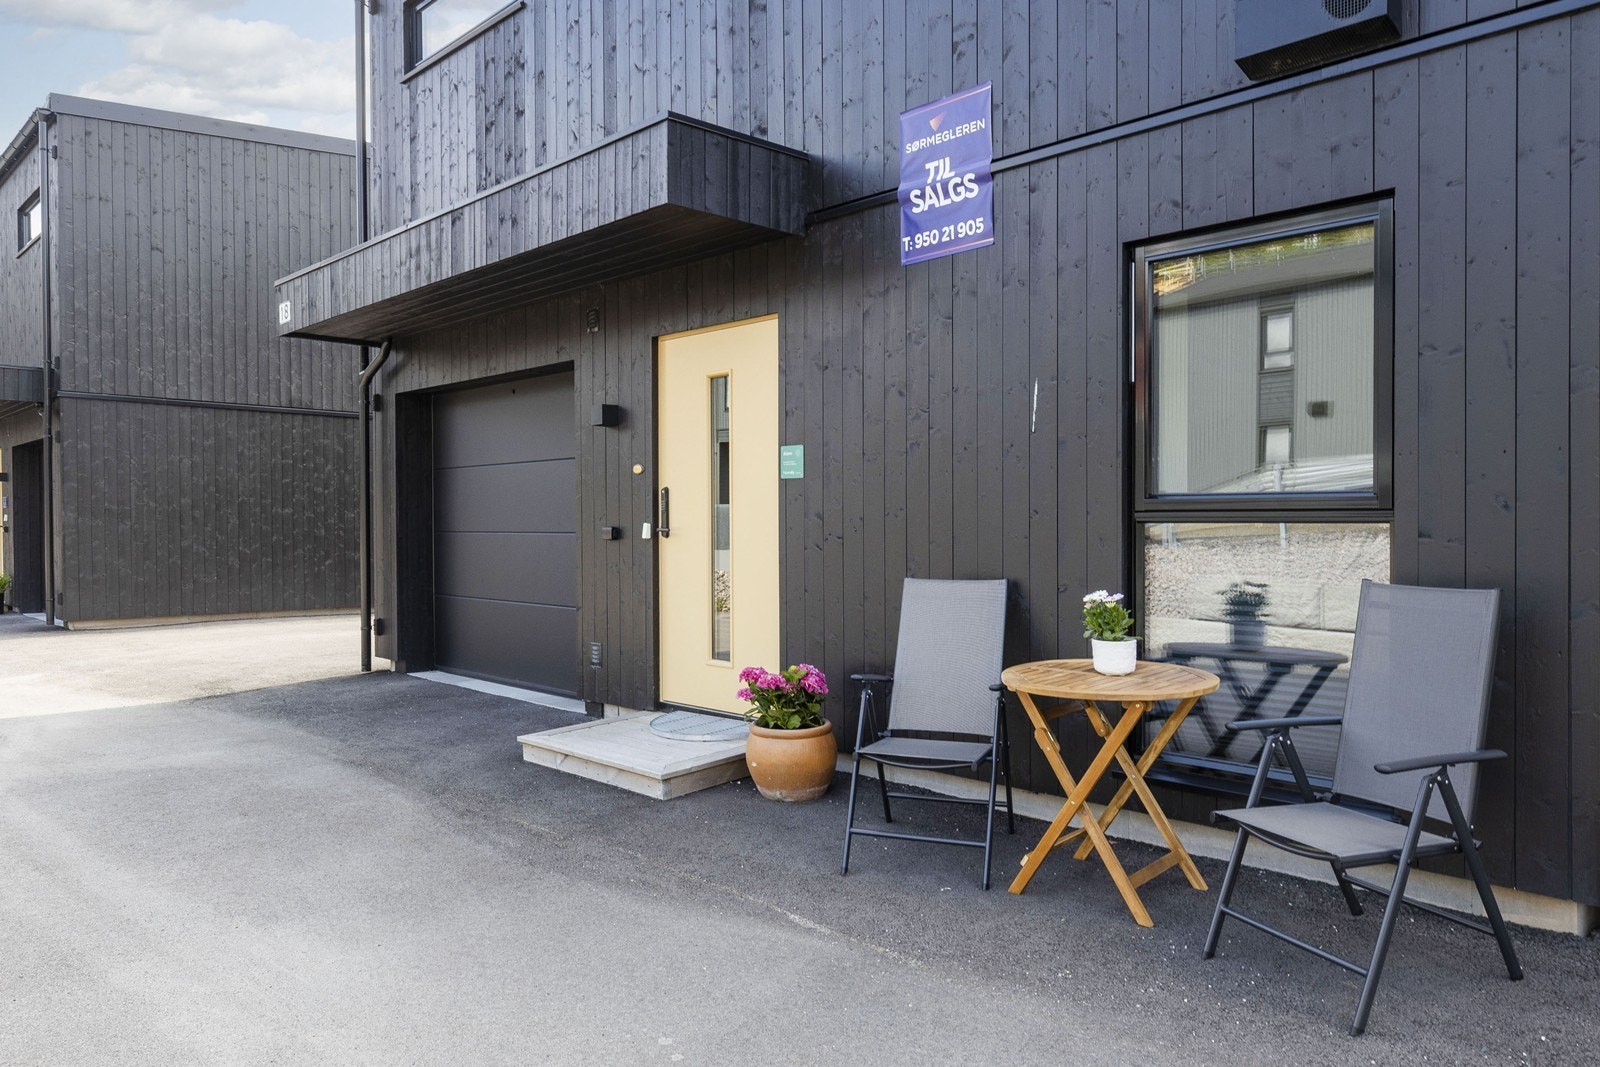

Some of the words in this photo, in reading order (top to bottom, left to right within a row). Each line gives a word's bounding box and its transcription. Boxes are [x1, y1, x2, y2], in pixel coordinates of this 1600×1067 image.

[906, 118, 986, 154] SØRMEGLEREN
[925, 157, 955, 183] TIL
[910, 173, 979, 213] SALGS
[903, 237, 913, 252] T:
[915, 229, 939, 249] 950
[942, 225, 955, 242] 21
[958, 217, 984, 238] 905
